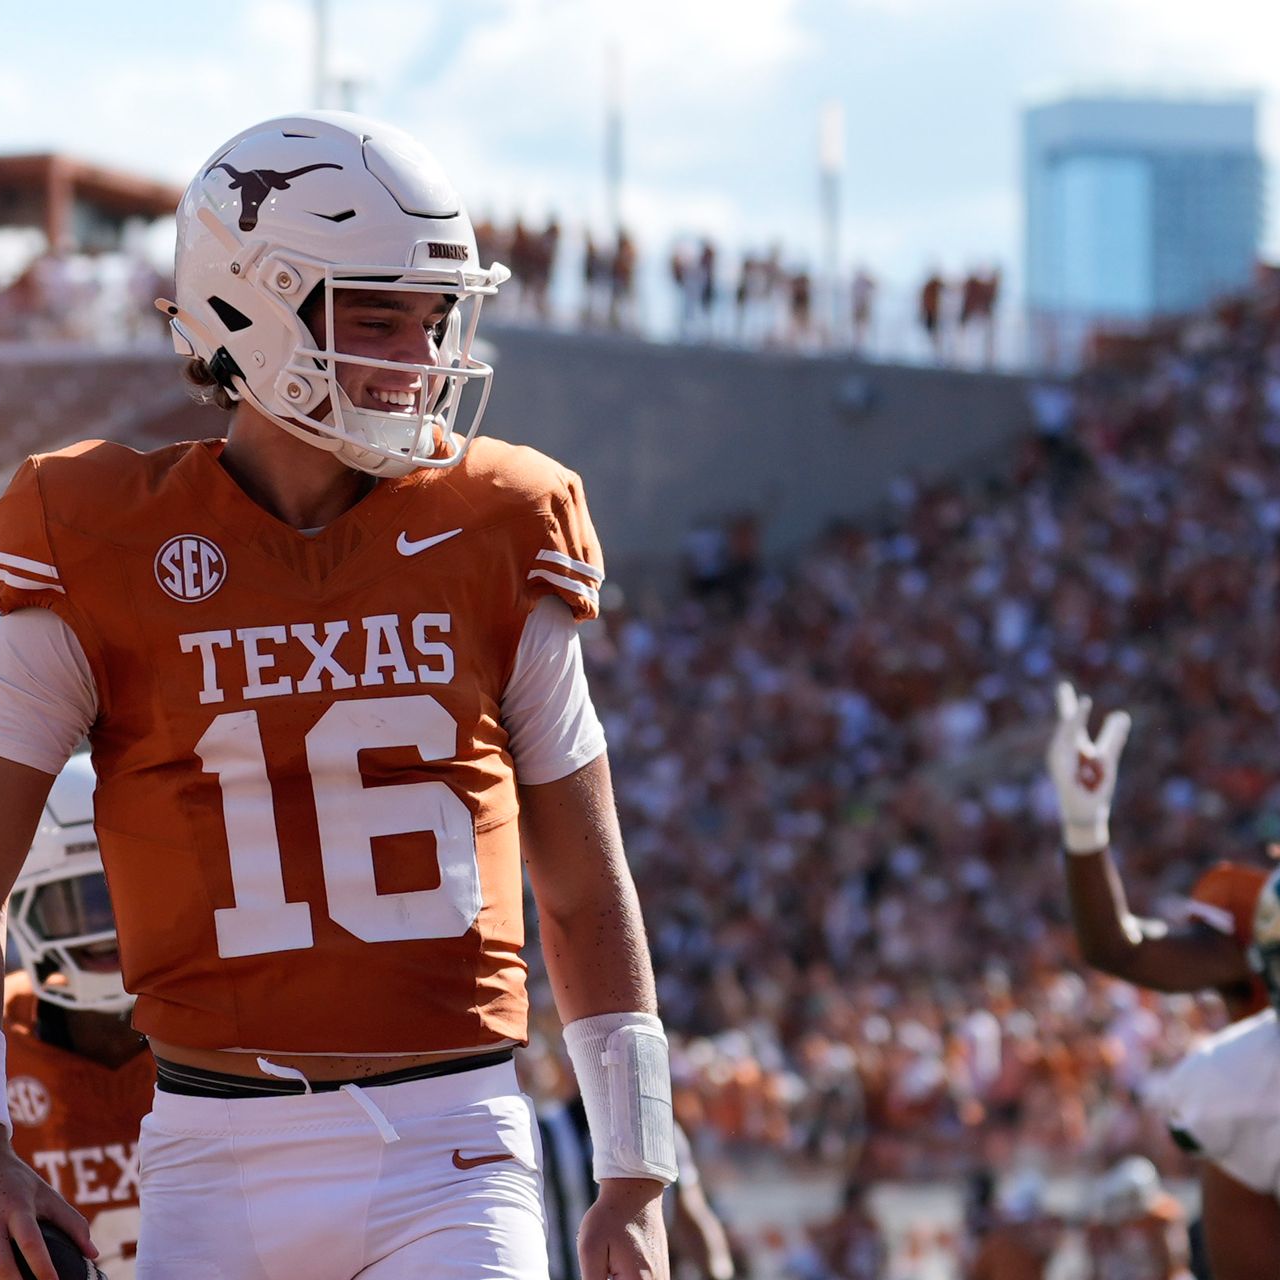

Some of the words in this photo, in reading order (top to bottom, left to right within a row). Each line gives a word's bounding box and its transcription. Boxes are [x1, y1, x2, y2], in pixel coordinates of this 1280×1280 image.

[160, 539, 220, 597] SEC
[179, 613, 455, 704] TEXAS
[193, 694, 483, 958] 16
